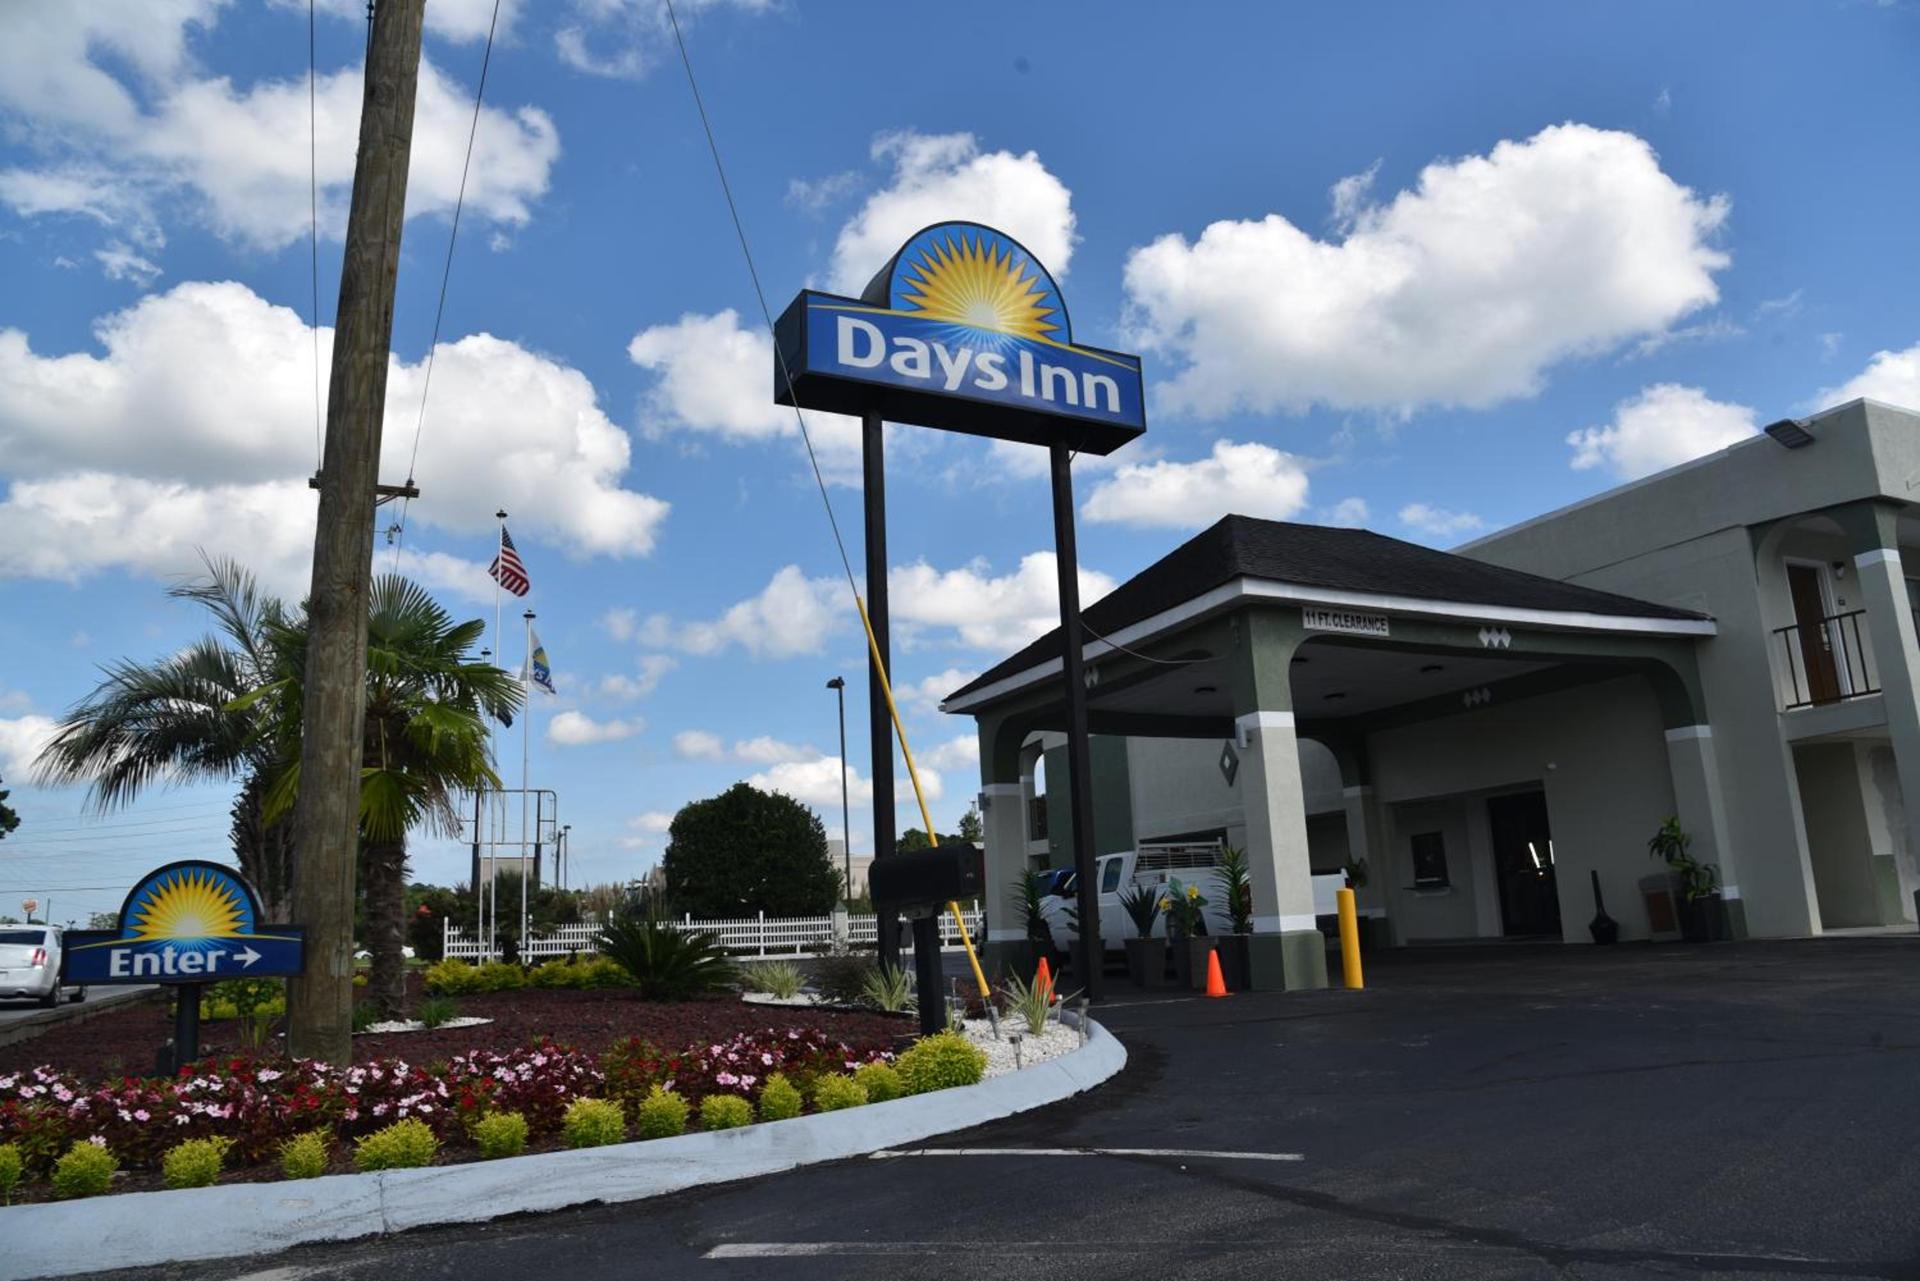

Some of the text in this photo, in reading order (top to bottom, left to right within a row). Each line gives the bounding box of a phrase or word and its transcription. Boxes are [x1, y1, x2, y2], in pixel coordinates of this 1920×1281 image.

[837, 315, 1121, 413] Days Inn
[1305, 610, 1316, 625] 11
[1332, 613, 1387, 632] CLEARANCE
[109, 946, 226, 977] Enter
